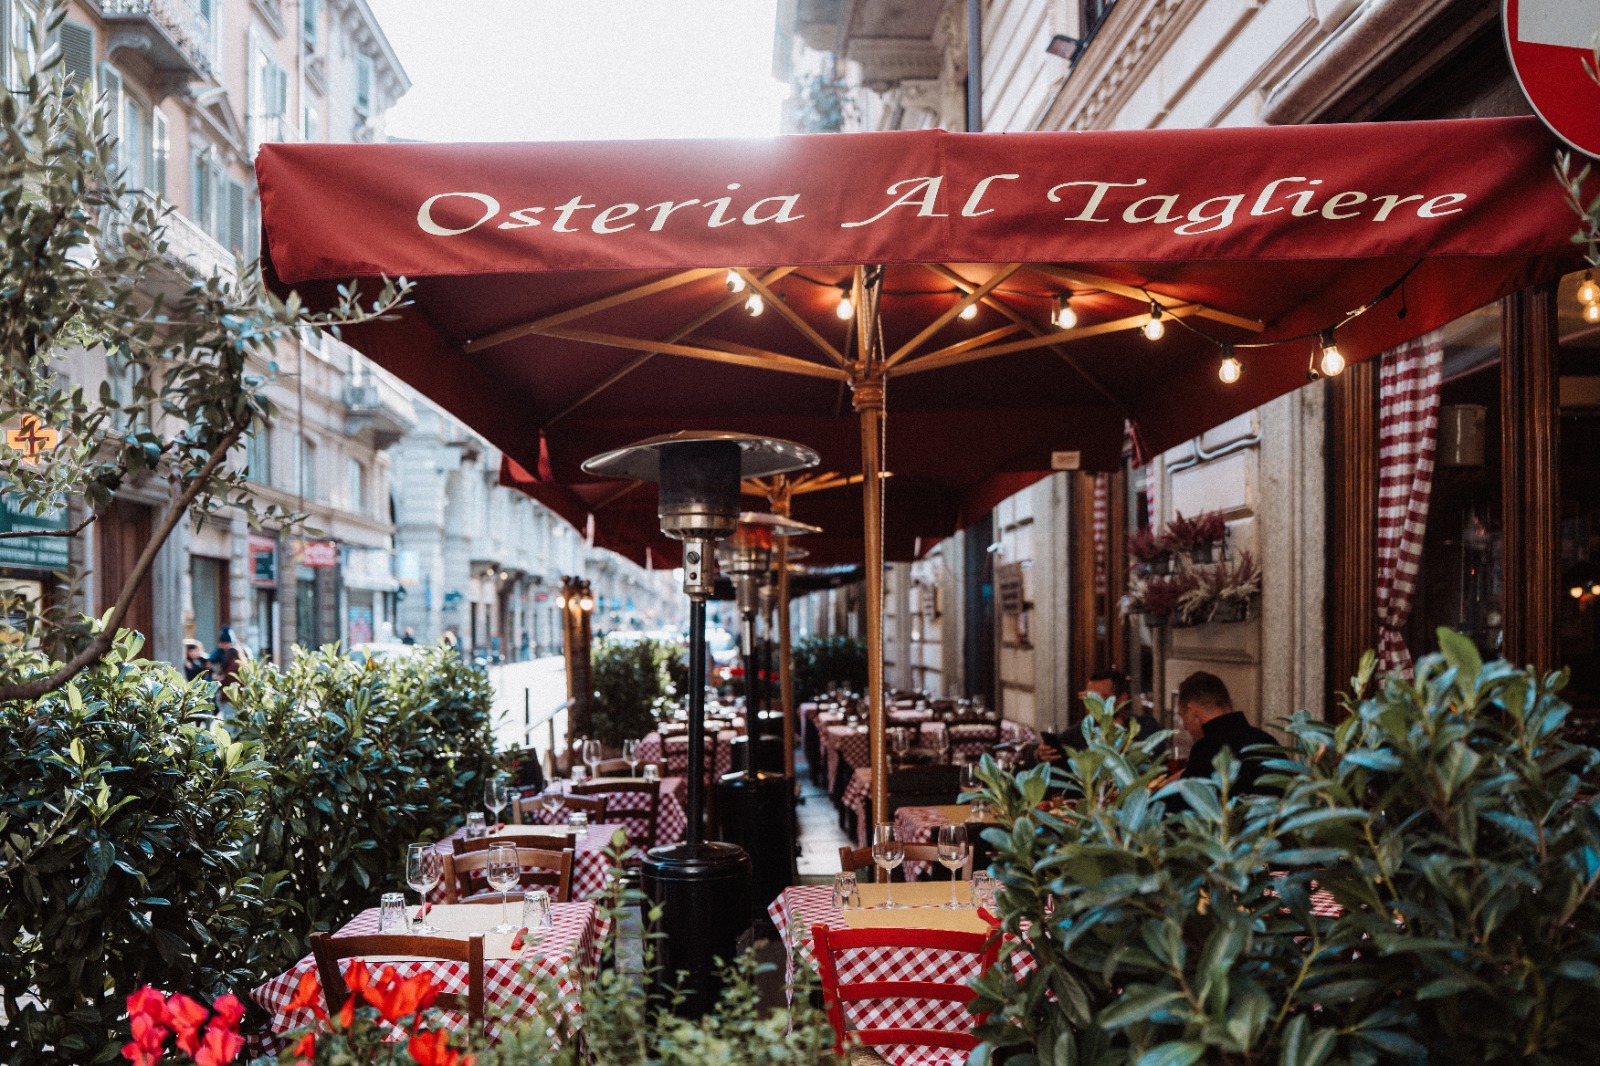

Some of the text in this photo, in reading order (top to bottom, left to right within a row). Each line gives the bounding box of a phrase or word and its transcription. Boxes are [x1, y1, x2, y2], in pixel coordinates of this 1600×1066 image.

[416, 174, 1468, 237] Osteria Al Tagliere
